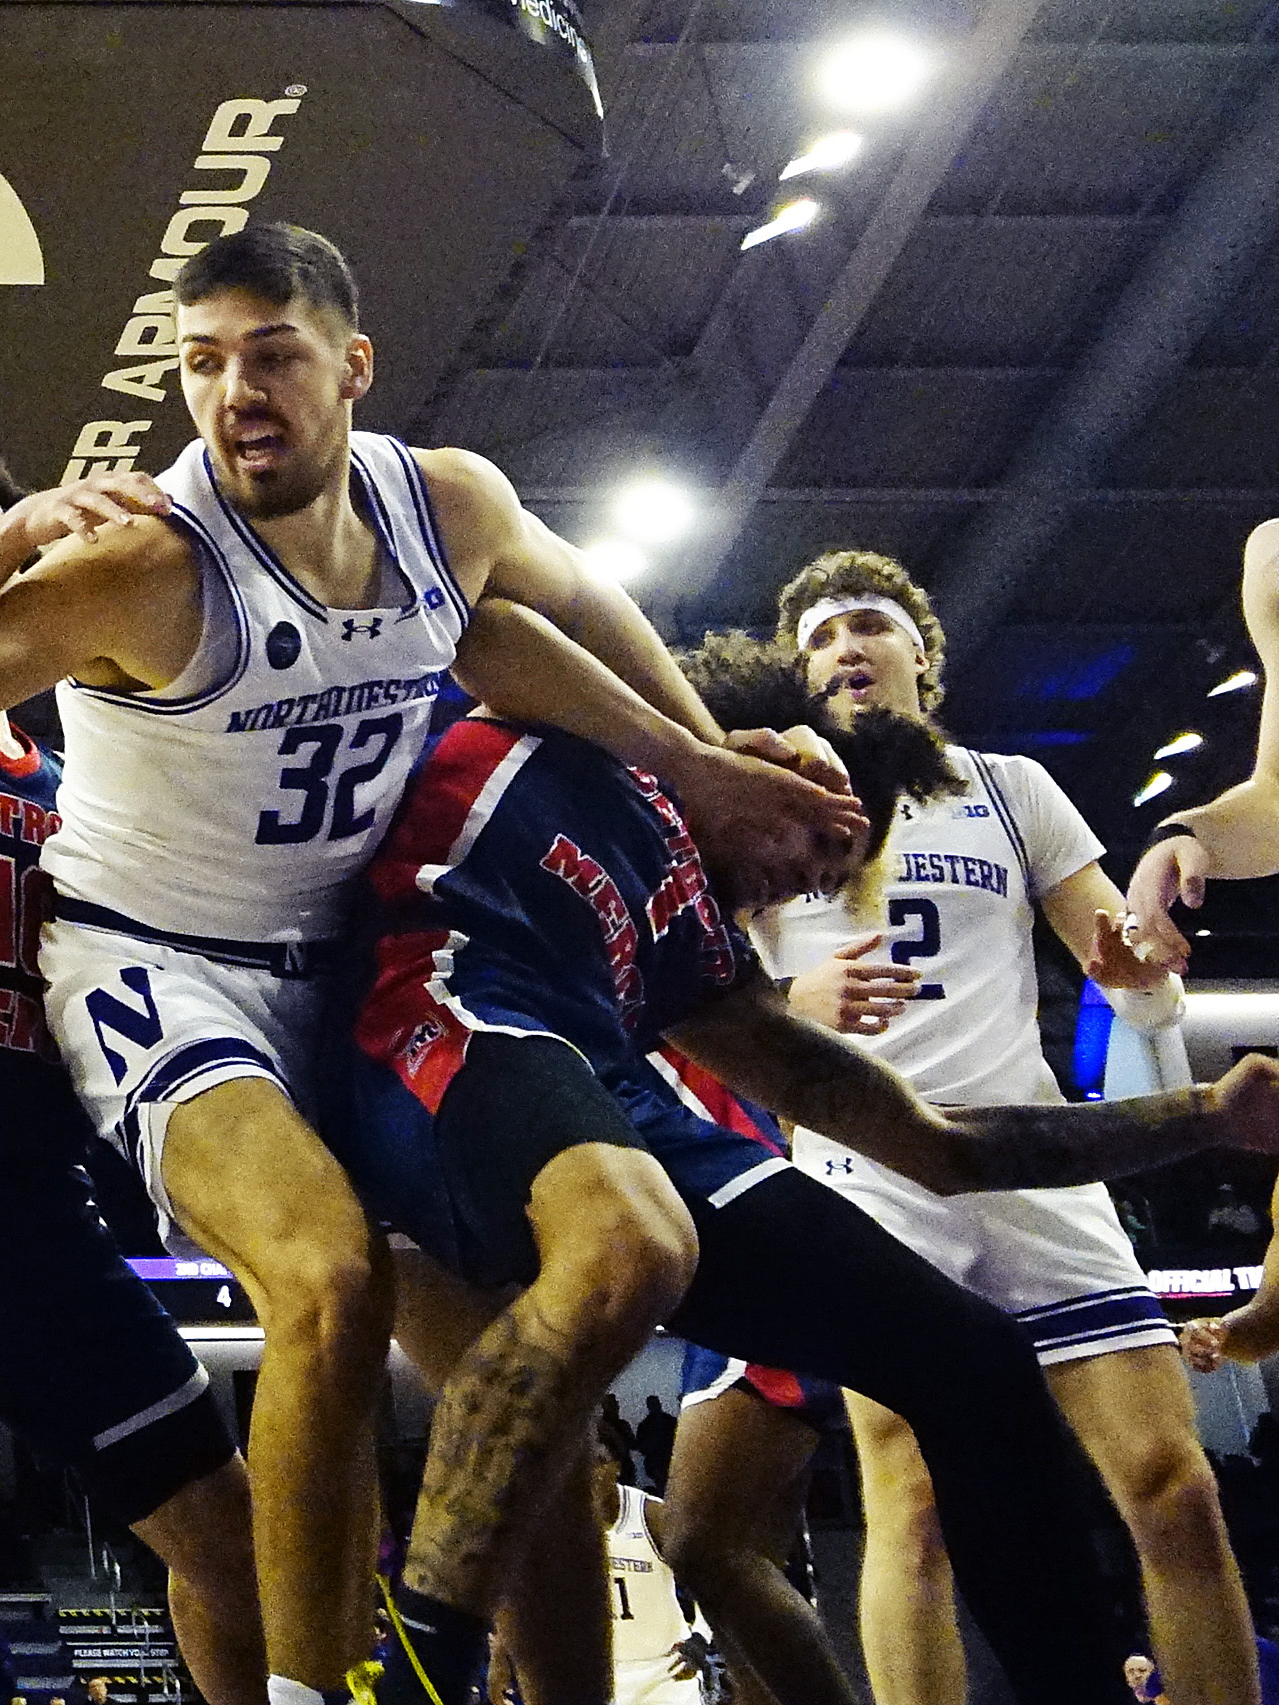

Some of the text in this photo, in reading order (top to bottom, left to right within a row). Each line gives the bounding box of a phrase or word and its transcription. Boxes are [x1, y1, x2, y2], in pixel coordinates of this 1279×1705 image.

[255, 712, 404, 845] 32
[888, 898, 946, 1000] 2
[85, 966, 164, 1088] N
[216, 1285, 232, 1308] 4
[1148, 1268, 1235, 1293] OFFICIAL
